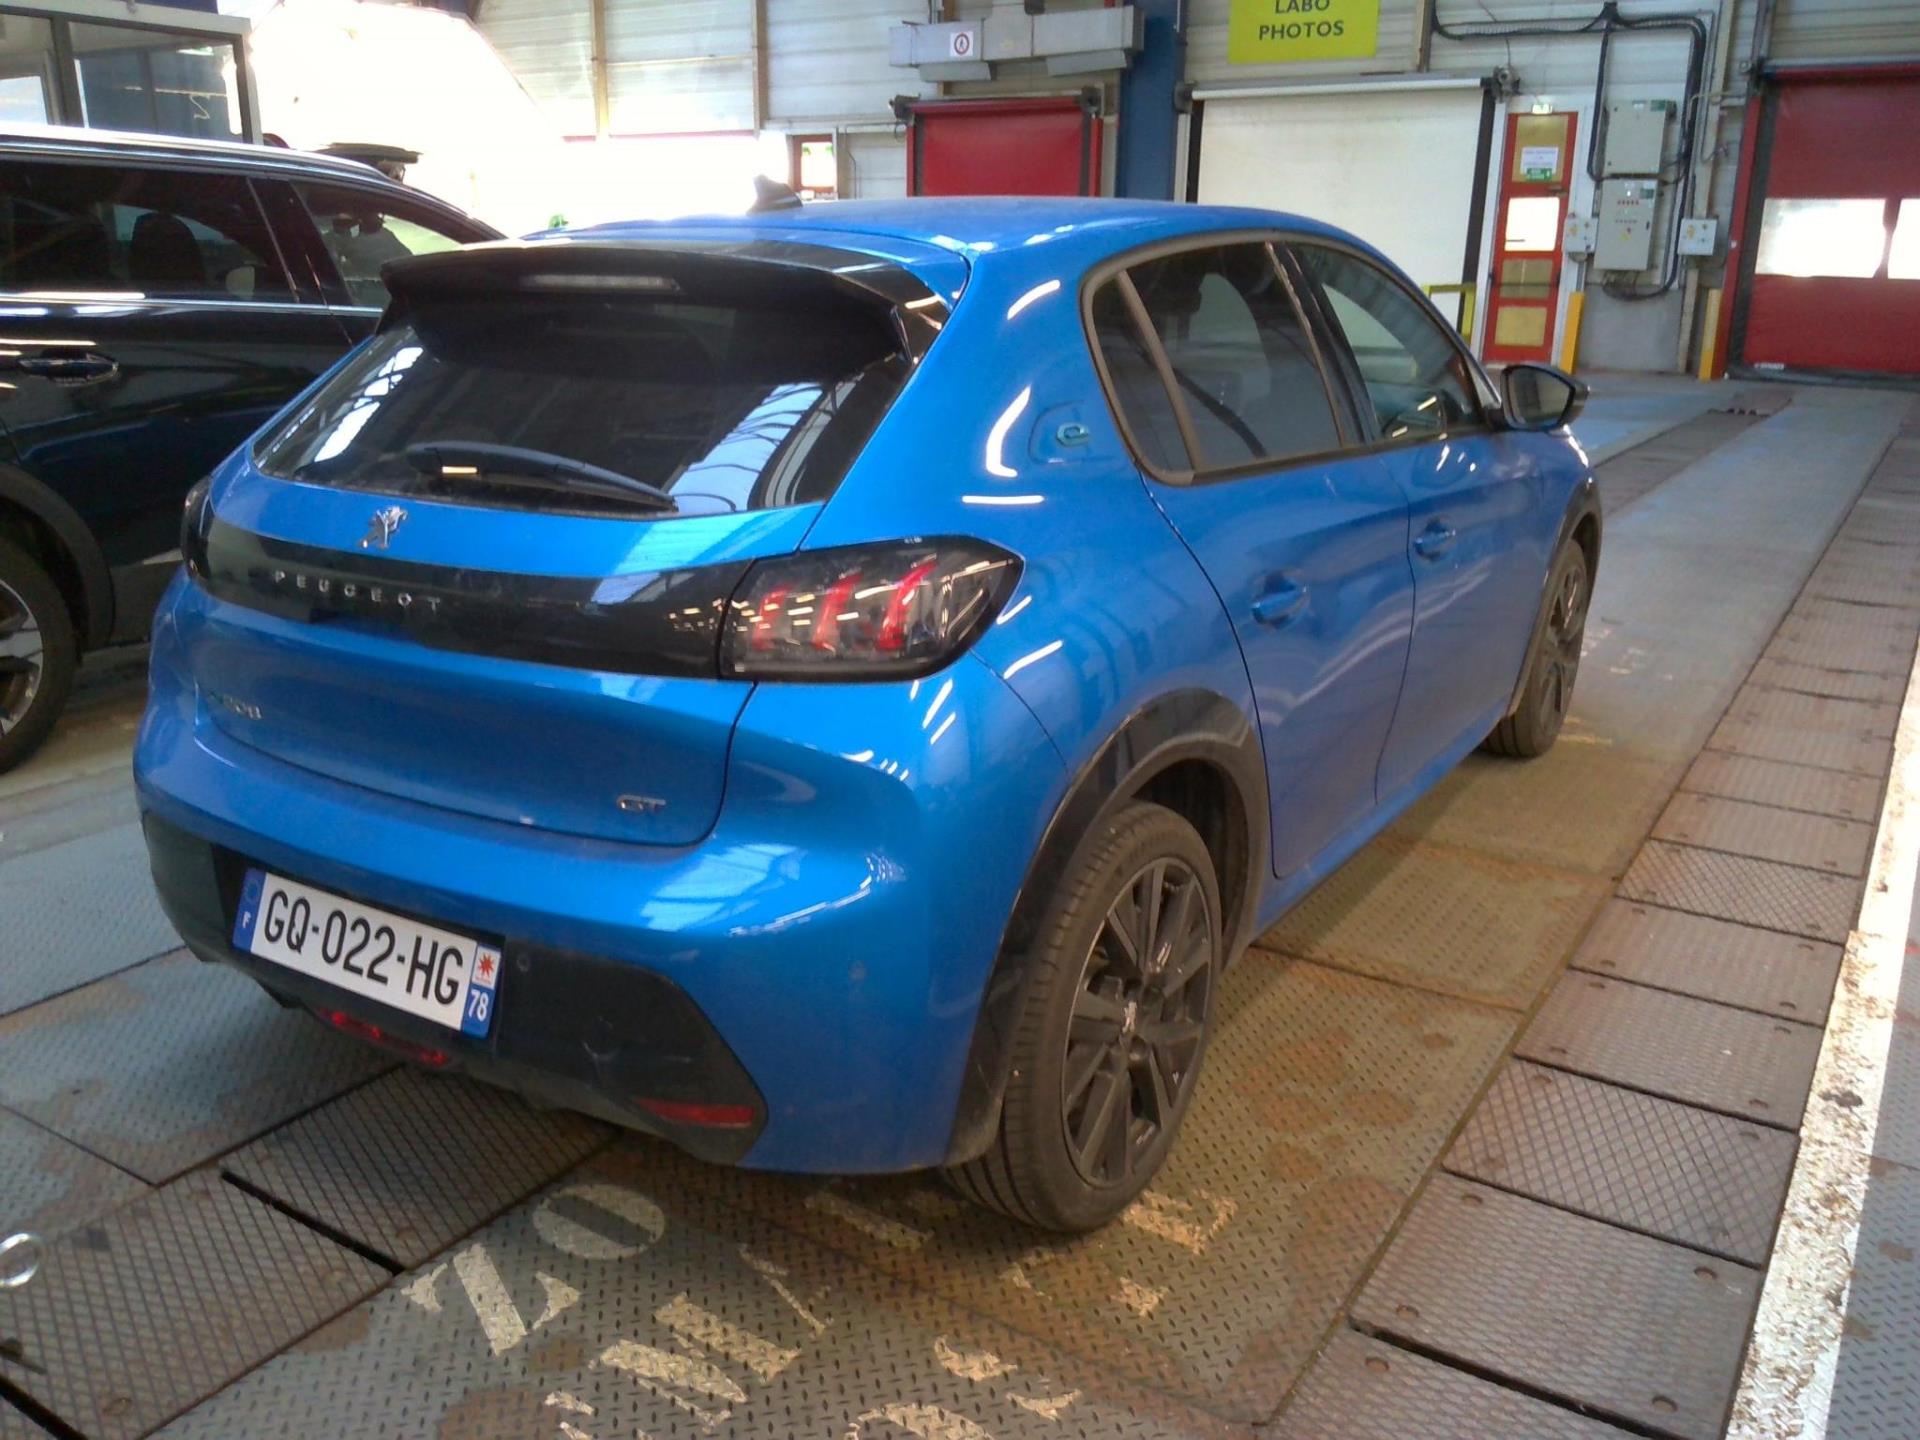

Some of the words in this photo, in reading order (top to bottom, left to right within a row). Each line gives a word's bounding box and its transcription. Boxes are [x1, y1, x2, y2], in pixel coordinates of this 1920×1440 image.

[1274, 0, 1330, 14] LABO
[1258, 20, 1344, 41] PHOTOS
[274, 570, 441, 613] PEUGEOT
[242, 911, 251, 929] F
[264, 890, 464, 1005] GQ-022-HG
[468, 989, 489, 1021] 78
